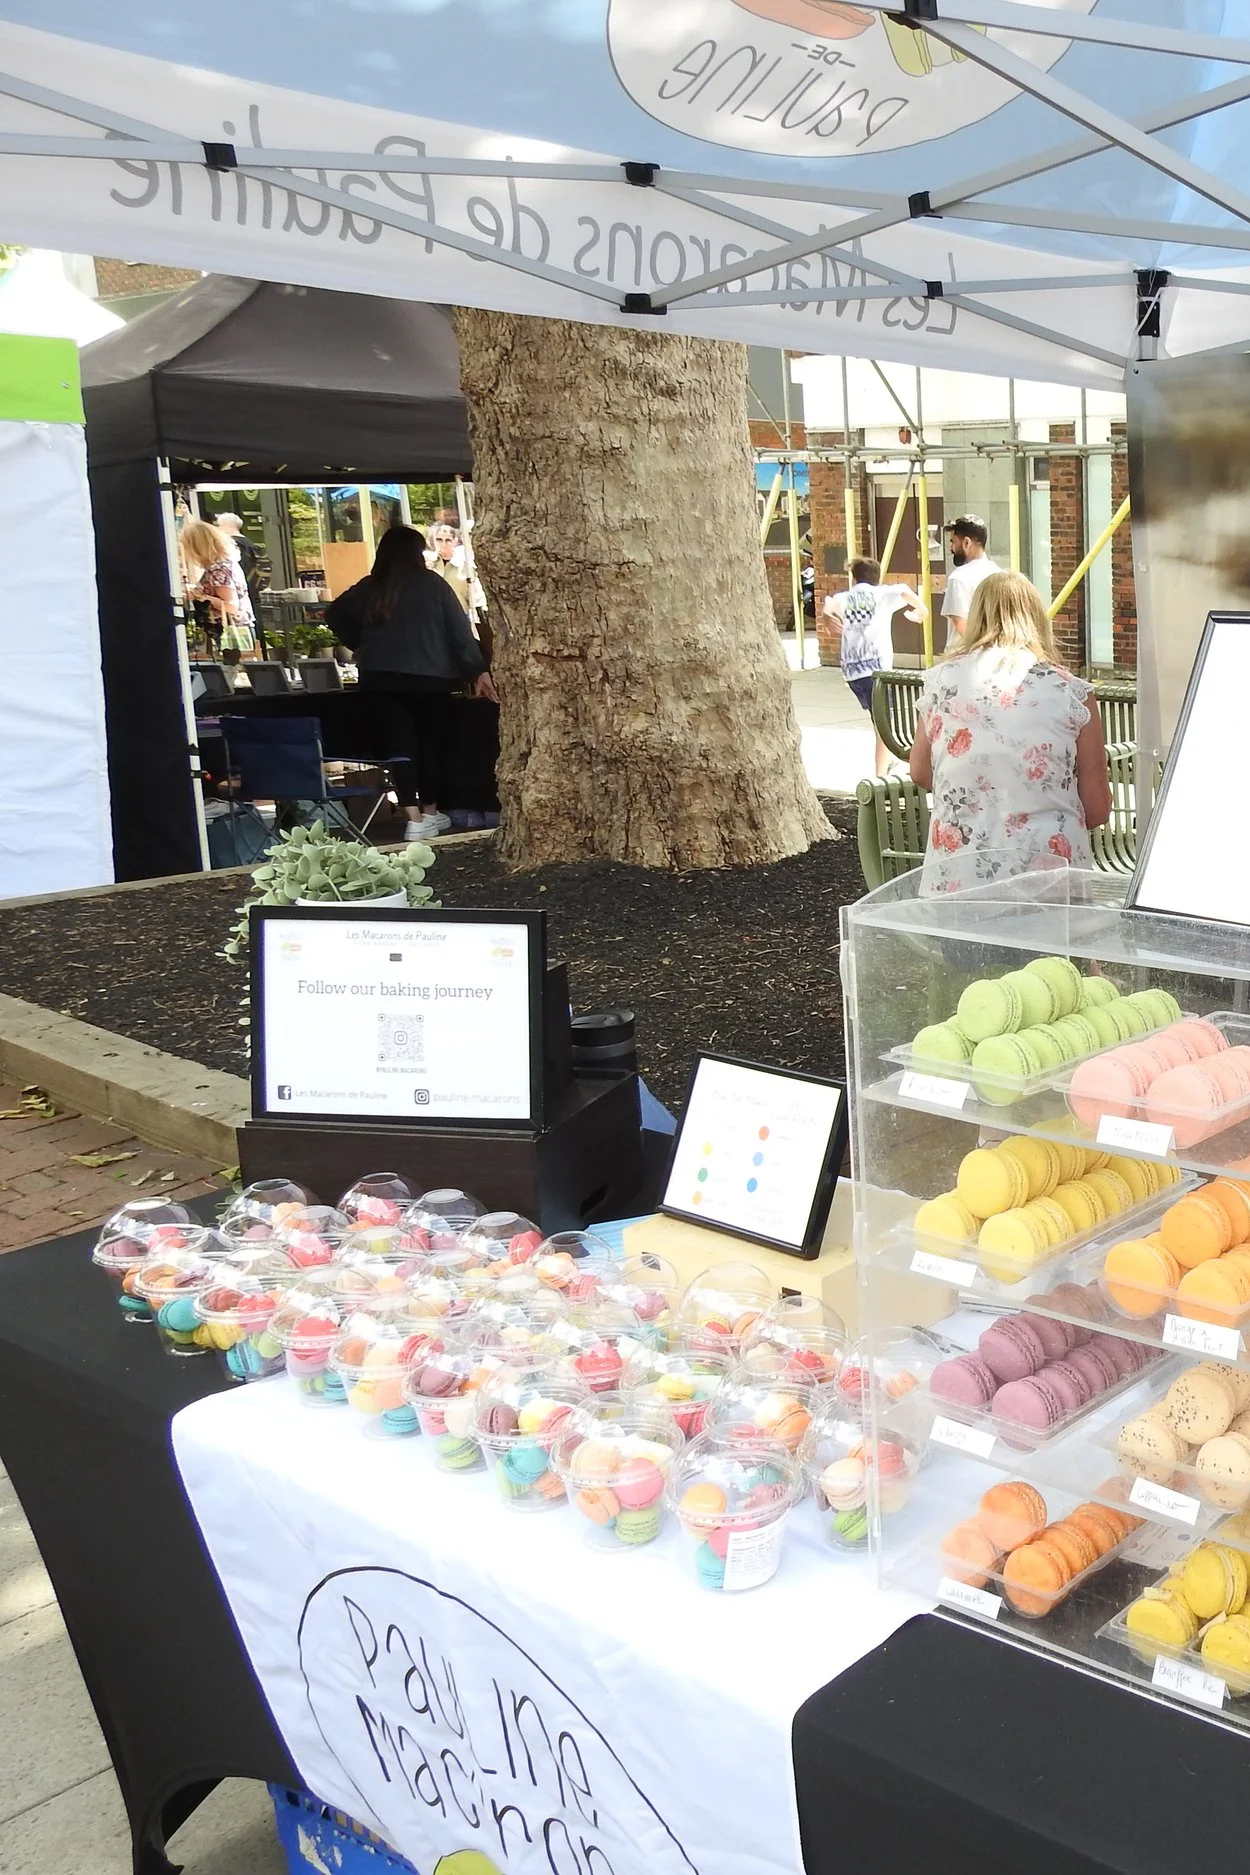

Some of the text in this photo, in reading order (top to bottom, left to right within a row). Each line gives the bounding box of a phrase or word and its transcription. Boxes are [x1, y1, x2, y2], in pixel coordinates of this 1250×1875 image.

[346, 929, 448, 942] Les Macarons de Pauline
[298, 980, 494, 1001] Follow our baking journey
